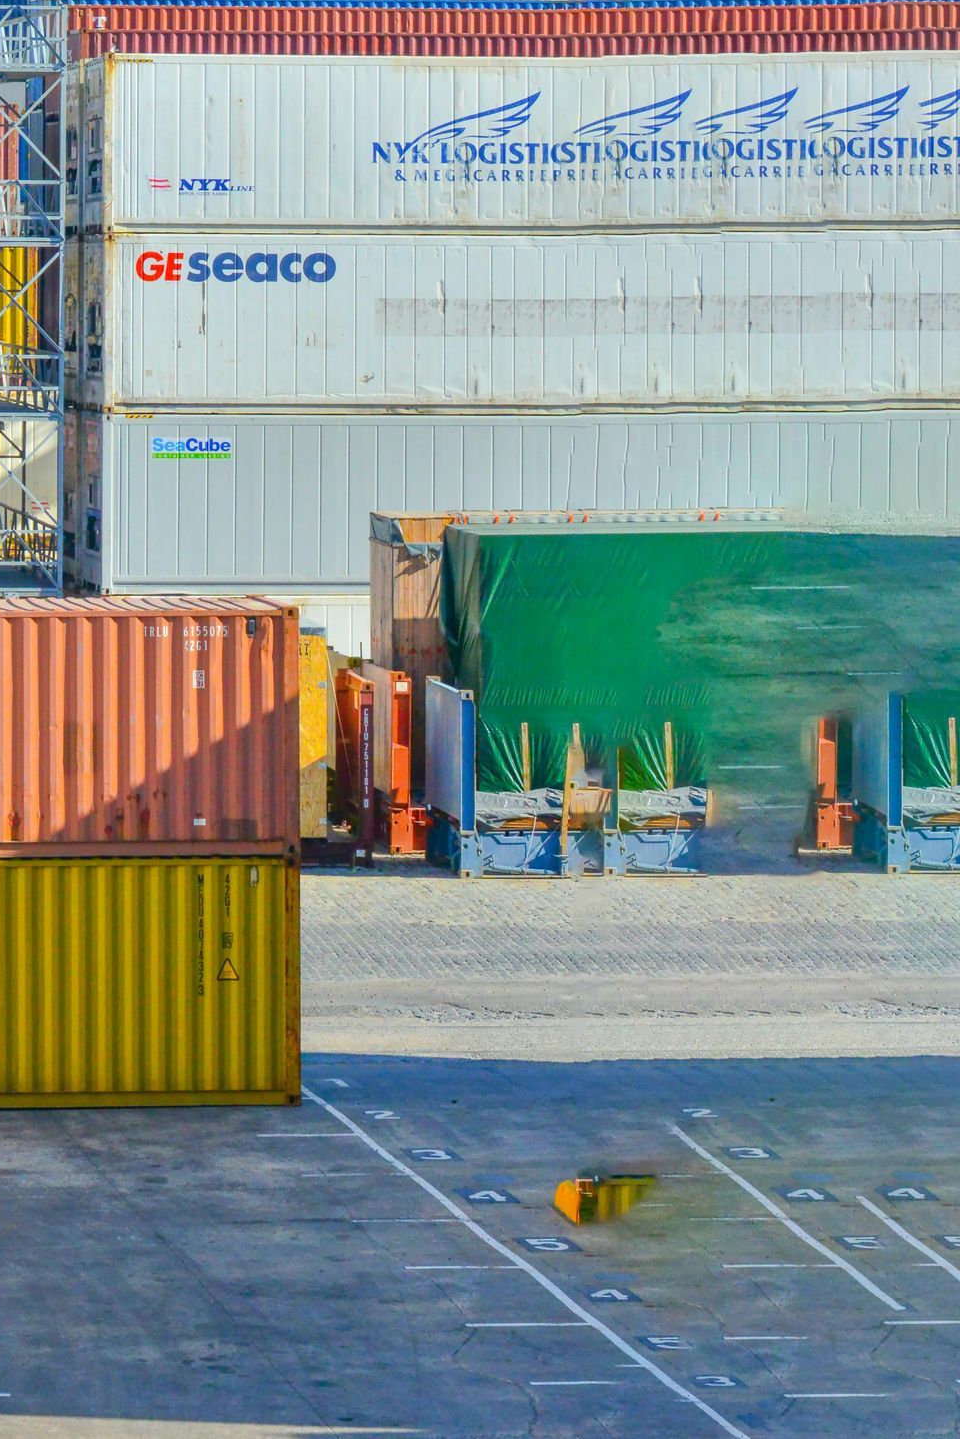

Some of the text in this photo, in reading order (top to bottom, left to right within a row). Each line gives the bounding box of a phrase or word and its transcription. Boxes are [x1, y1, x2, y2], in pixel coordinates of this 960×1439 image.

[394, 169, 407, 182] &
[179, 178, 231, 191] NYK
[152, 438, 231, 452] SeaCube
[143, 625, 169, 638] TRLU
[412, 1149, 452, 1160] 3
[729, 1147, 770, 1158] 3
[525, 1238, 569, 1251] 5
